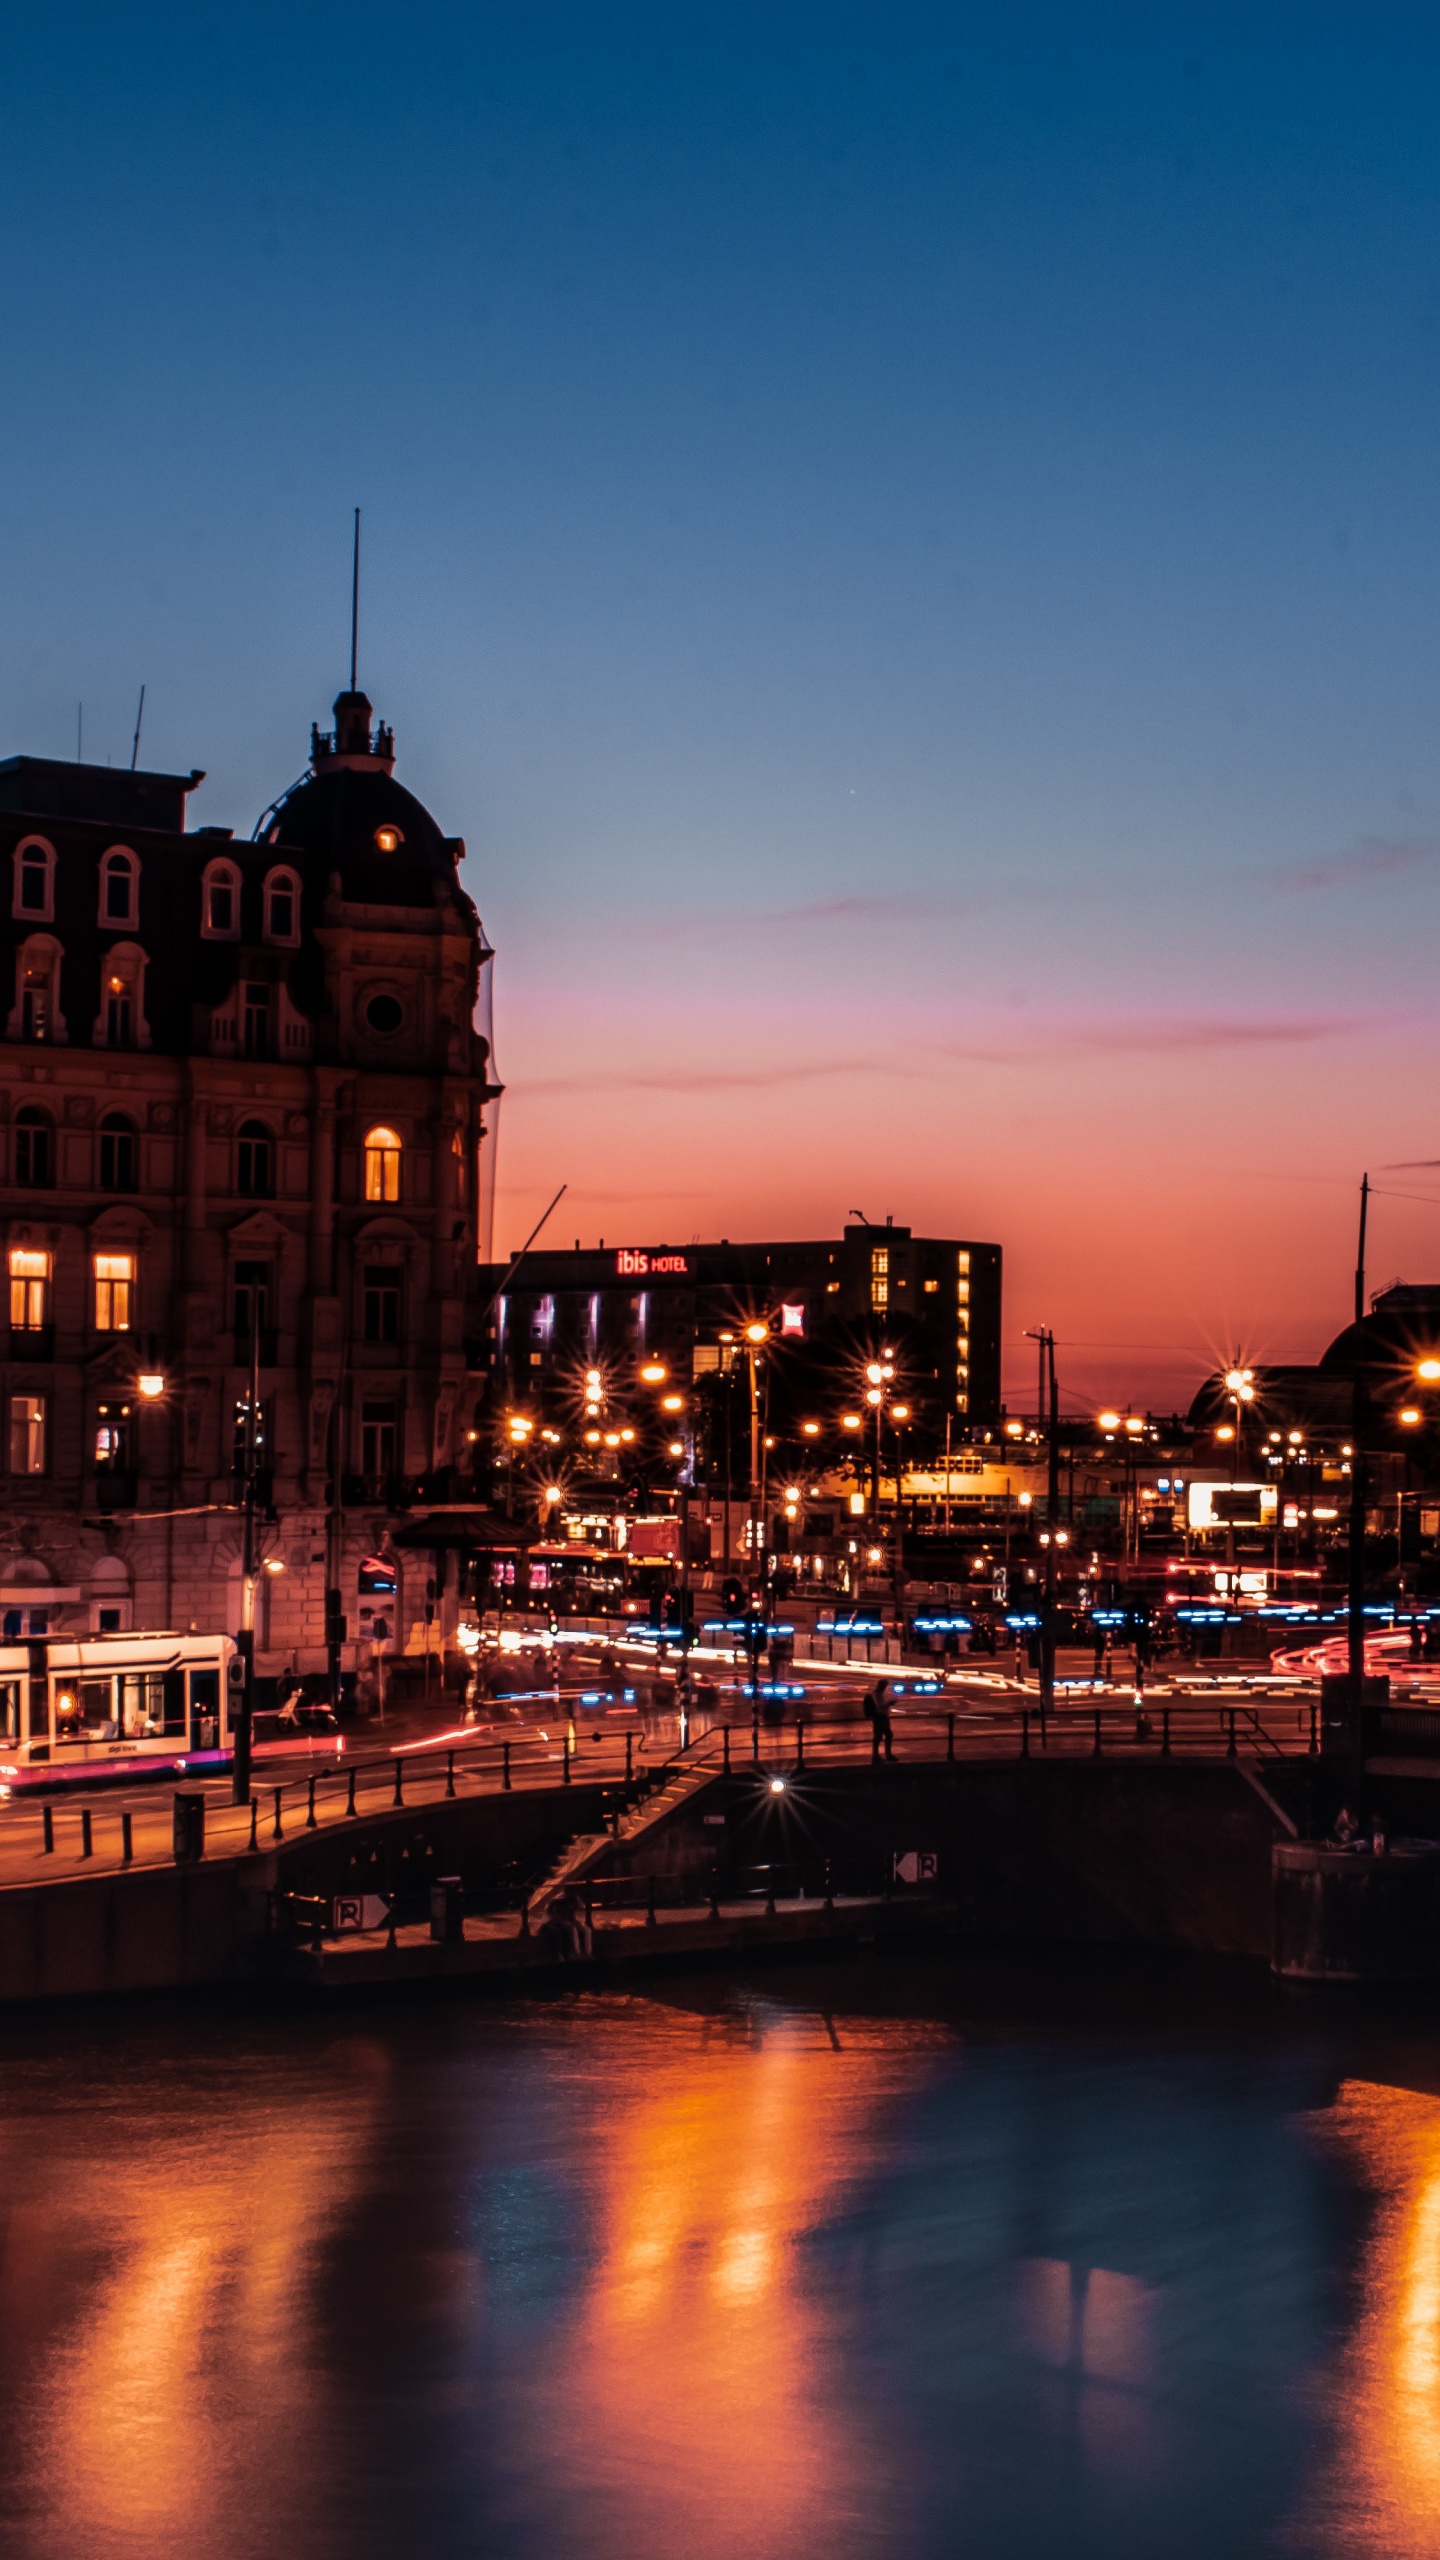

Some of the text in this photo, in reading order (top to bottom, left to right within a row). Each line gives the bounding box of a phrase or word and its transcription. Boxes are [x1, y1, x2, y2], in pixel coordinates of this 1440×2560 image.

[617, 1249, 688, 1274] ibis HOTEL
[920, 1855, 937, 1879] R
[340, 1902, 360, 1926] R
